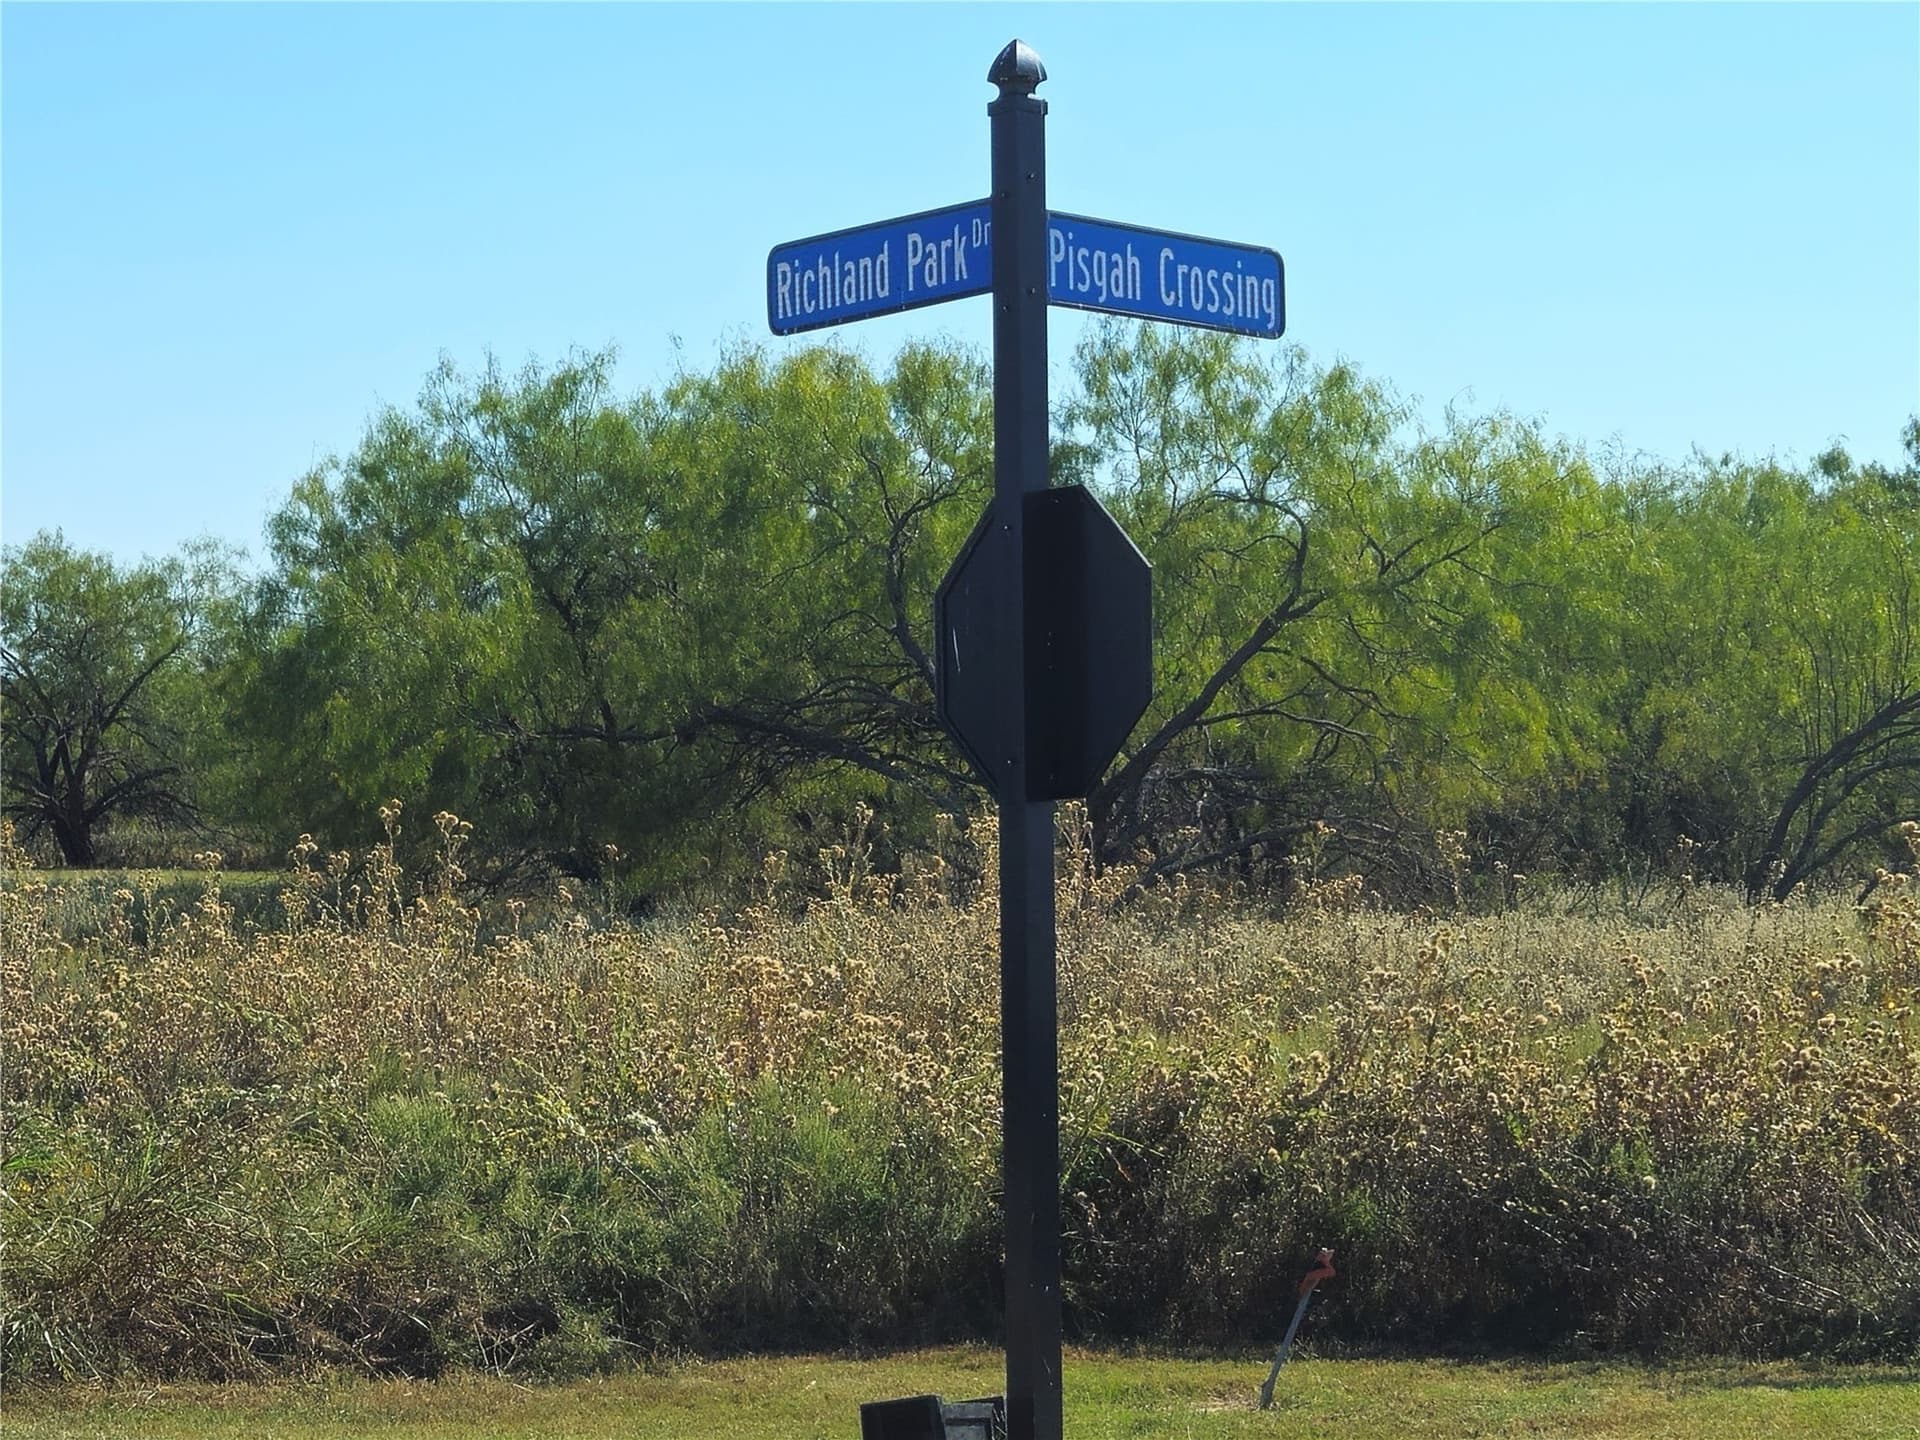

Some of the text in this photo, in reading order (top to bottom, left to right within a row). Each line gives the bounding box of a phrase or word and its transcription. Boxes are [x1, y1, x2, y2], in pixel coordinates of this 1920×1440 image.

[777, 240, 889, 319] Richland
[907, 224, 968, 291] Park
[1049, 229, 1275, 329] Pisgah Crossing
